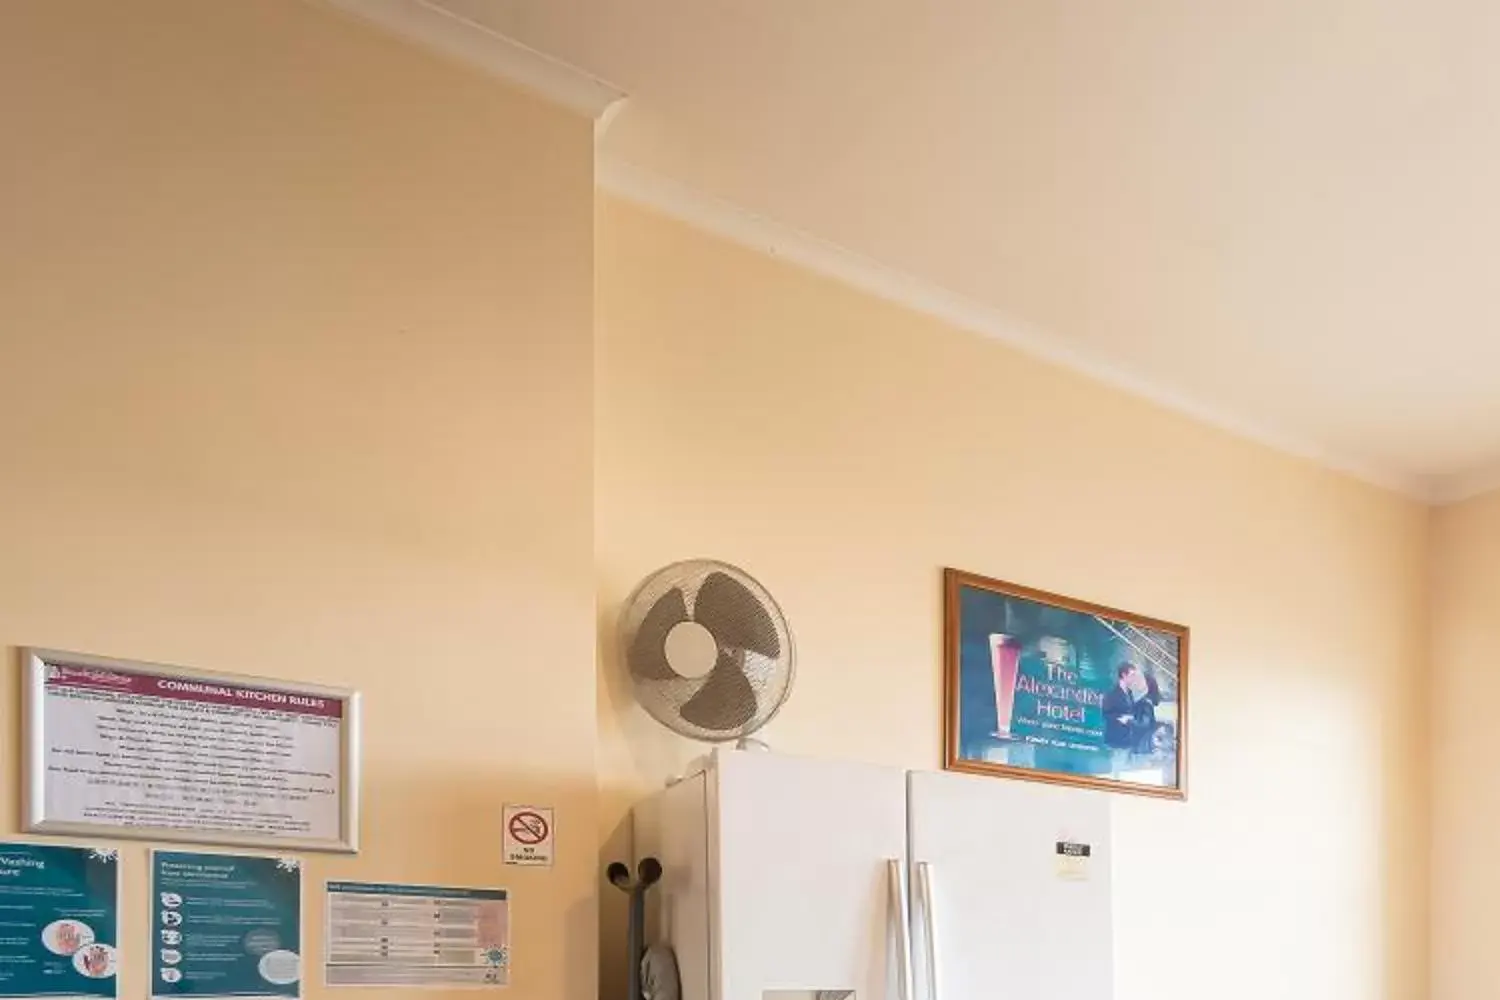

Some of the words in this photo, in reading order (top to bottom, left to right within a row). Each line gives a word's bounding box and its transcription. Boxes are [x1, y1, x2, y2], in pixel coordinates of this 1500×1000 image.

[1046, 663, 1079, 685] The
[157, 678, 234, 698] COMMUNAL
[235, 688, 287, 704] KITCHEN
[288, 696, 326, 710] RULES
[1036, 699, 1086, 723] Hotel
